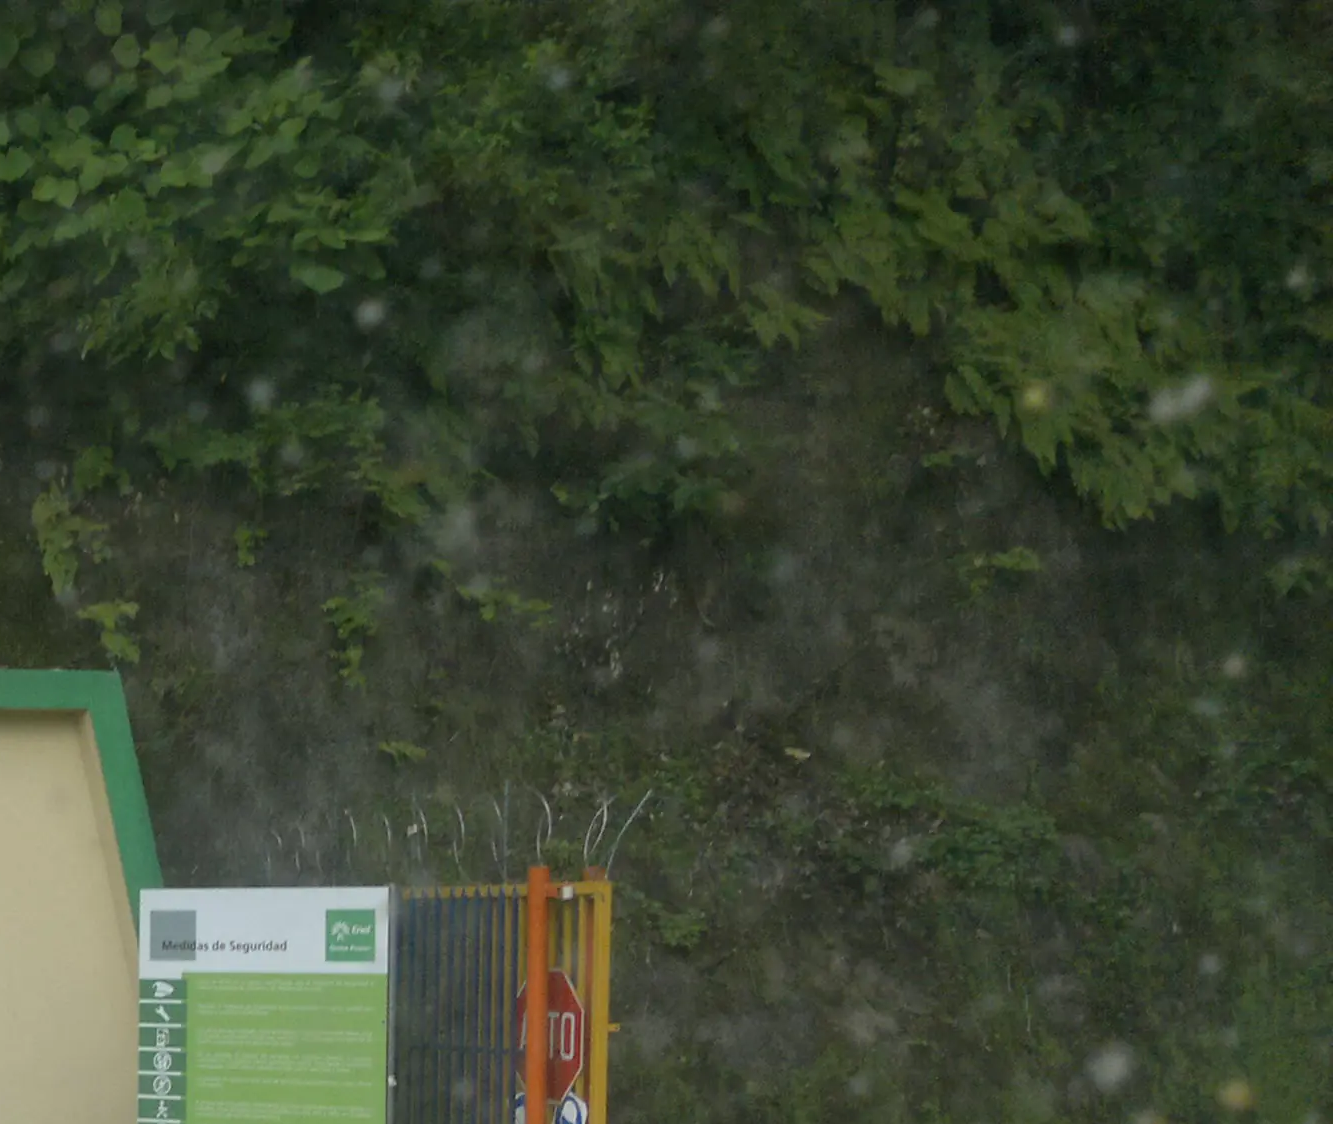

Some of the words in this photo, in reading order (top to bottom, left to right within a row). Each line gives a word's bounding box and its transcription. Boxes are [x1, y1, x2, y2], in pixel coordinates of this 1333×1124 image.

[161, 939, 209, 952] Medidas
[212, 940, 226, 952] de
[229, 939, 288, 954] Seguridad
